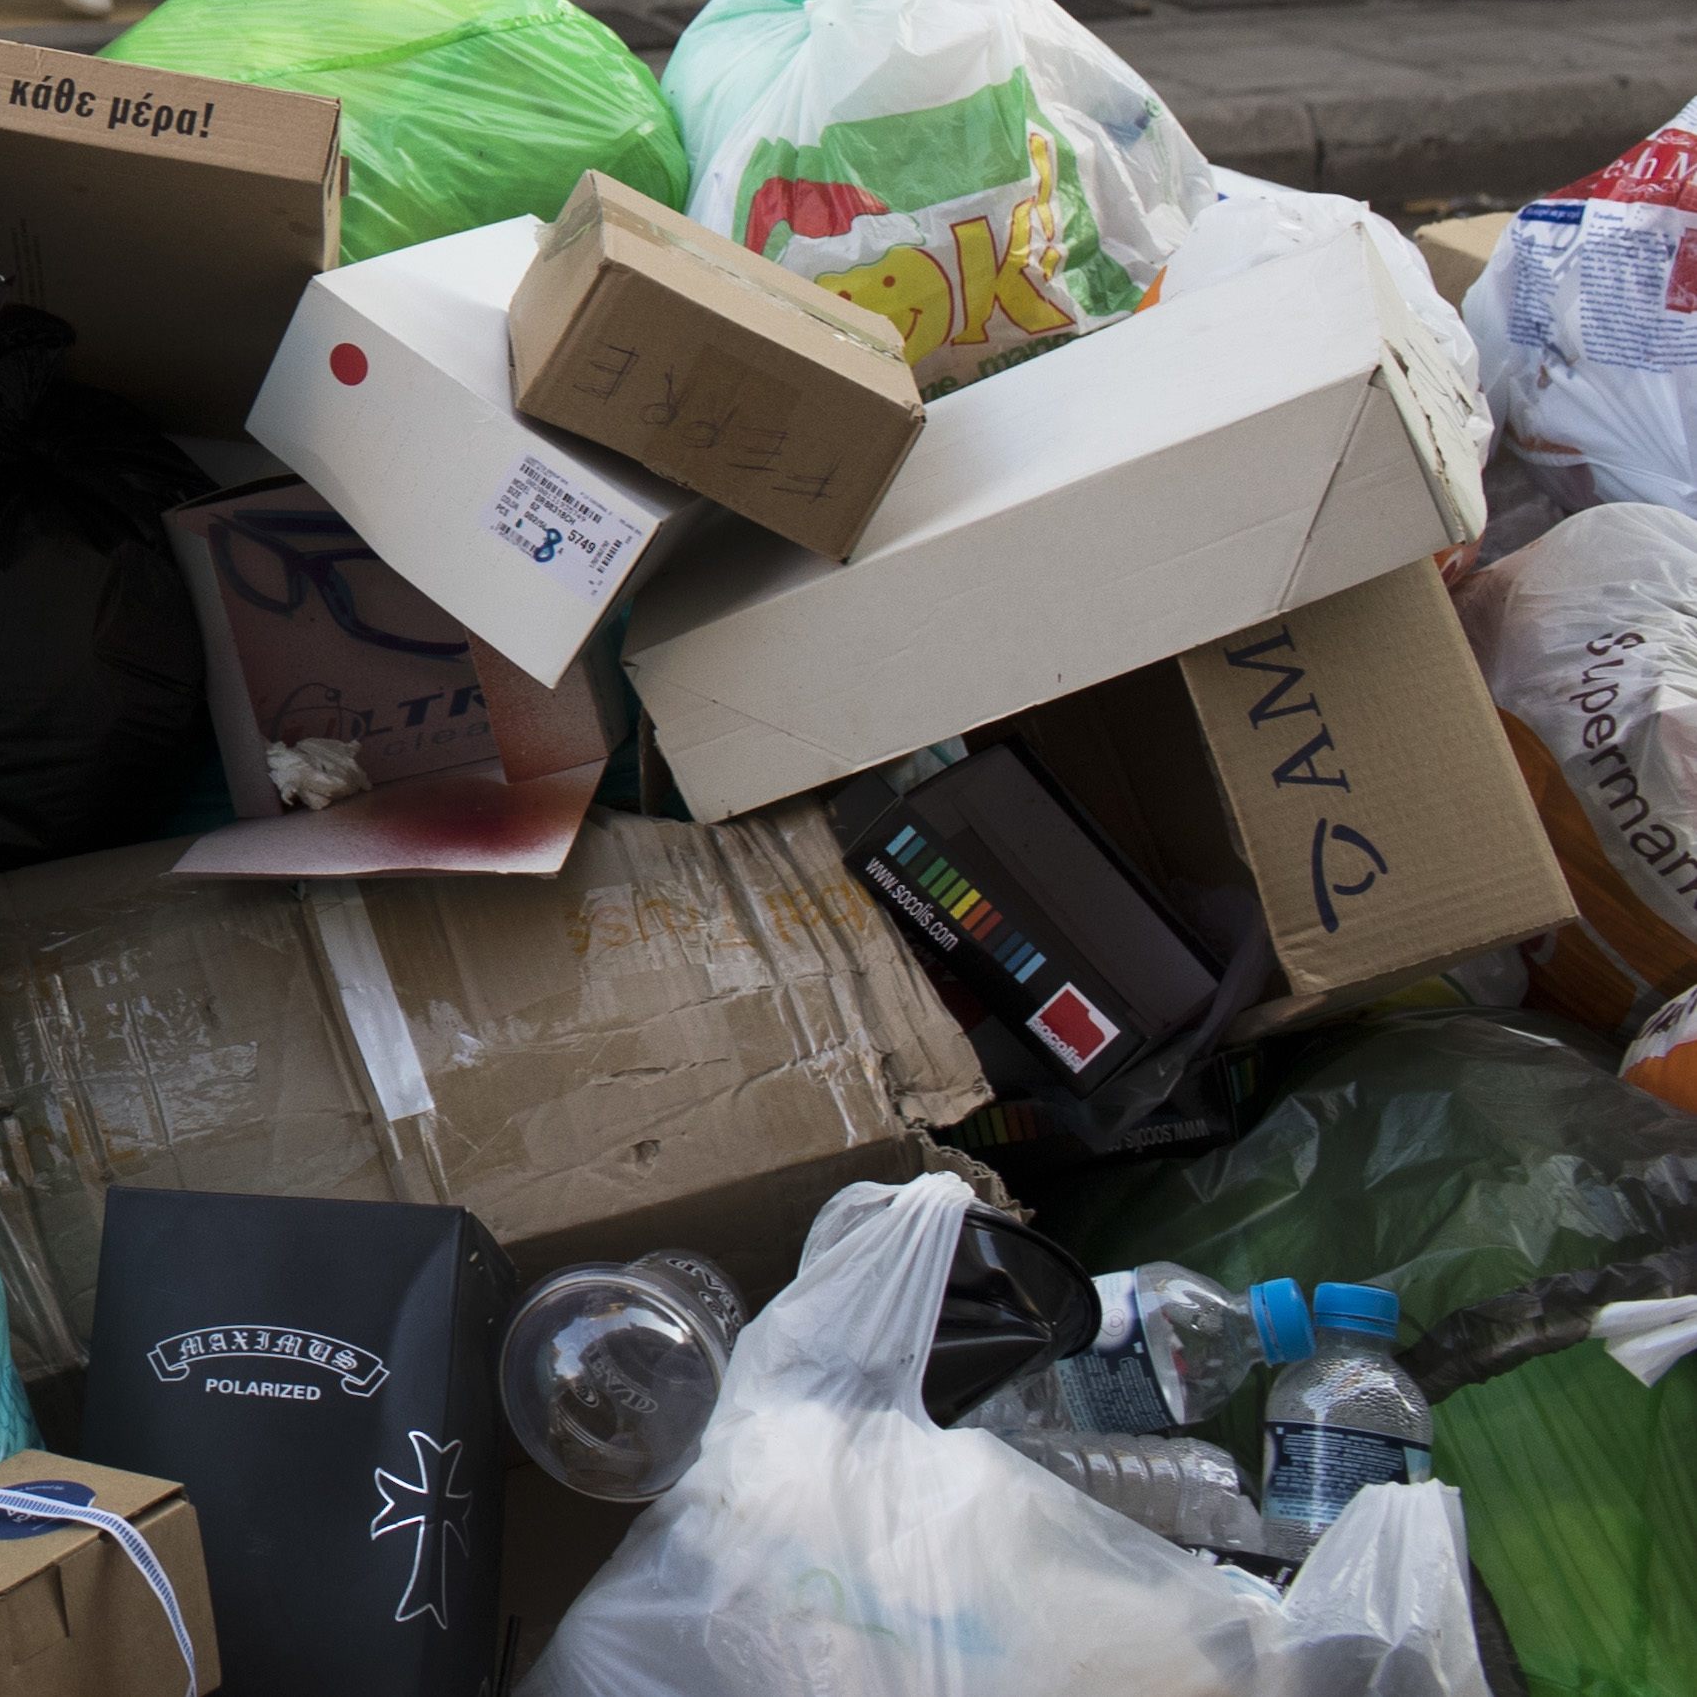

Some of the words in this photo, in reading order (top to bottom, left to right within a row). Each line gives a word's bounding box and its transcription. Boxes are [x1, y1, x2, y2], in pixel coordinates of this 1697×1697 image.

[9, 74, 97, 118] κάθε
[107, 93, 216, 138] μέρα!
[567, 529, 596, 554] 5749
[383, 719, 491, 758] clea
[1570, 631, 1697, 909] Supermar
[865, 856, 958, 952] www.socolis.com
[1031, 1016, 1084, 1069] socolis
[179, 1330, 357, 1370] MAXIMUS
[206, 1378, 321, 1401] POLARIZED
